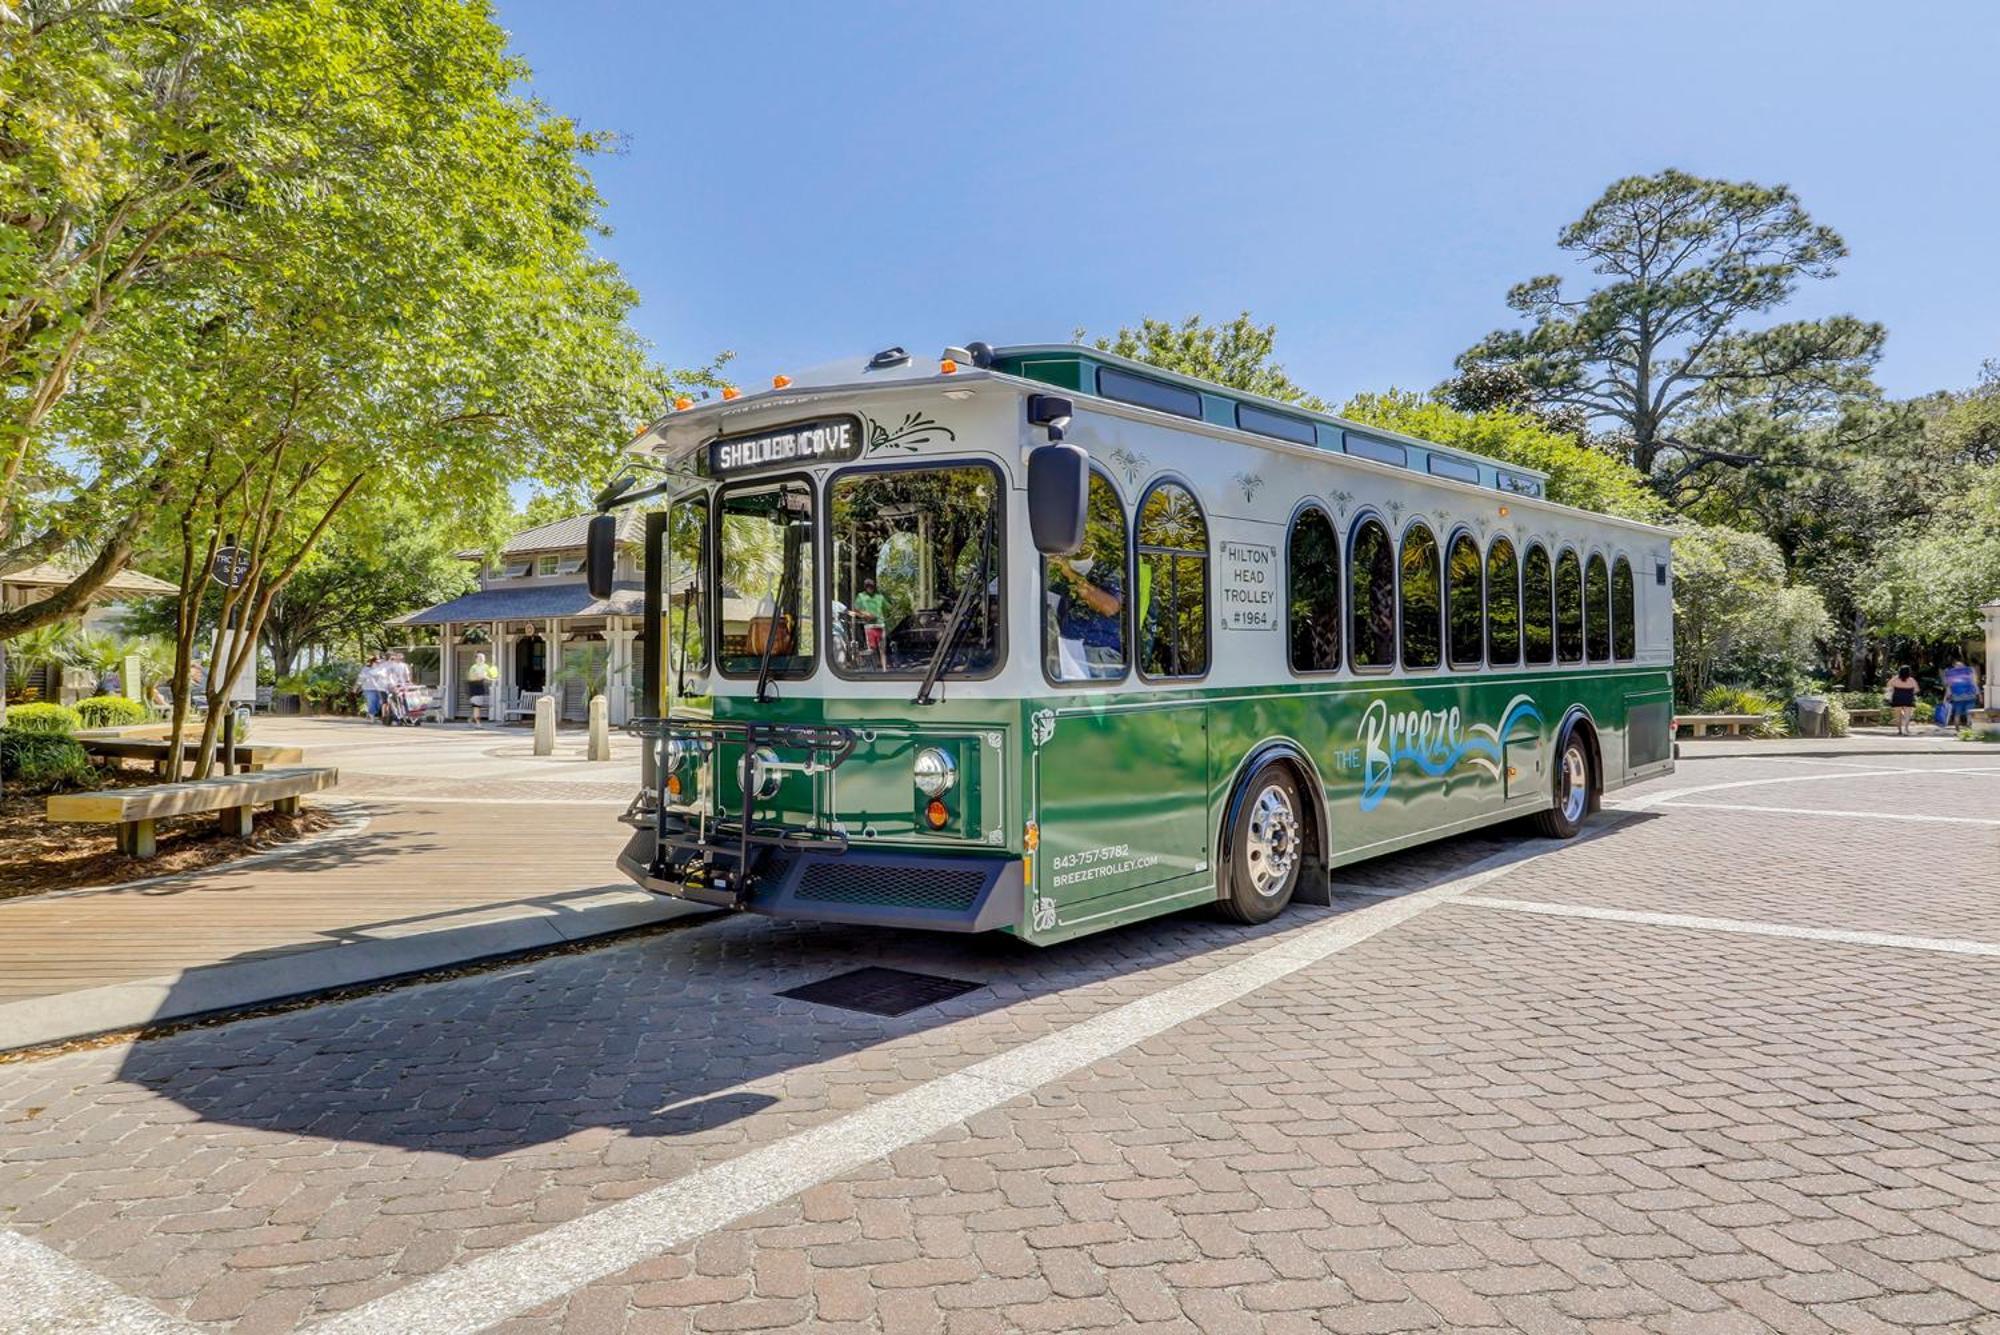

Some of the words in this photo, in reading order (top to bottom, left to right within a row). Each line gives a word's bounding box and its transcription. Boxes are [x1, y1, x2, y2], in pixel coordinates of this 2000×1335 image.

[1228, 547, 1269, 564] HILTON
[1234, 569, 1265, 584] HEAD
[1223, 588, 1274, 604] TROLLEY
[1234, 611, 1267, 625] #1964
[1334, 748, 1361, 769] THE
[1356, 699, 1465, 813] Breeze
[1053, 843, 1129, 870] 843-757-5782
[1053, 855, 1158, 888] BREEZETROLLEY.COM
